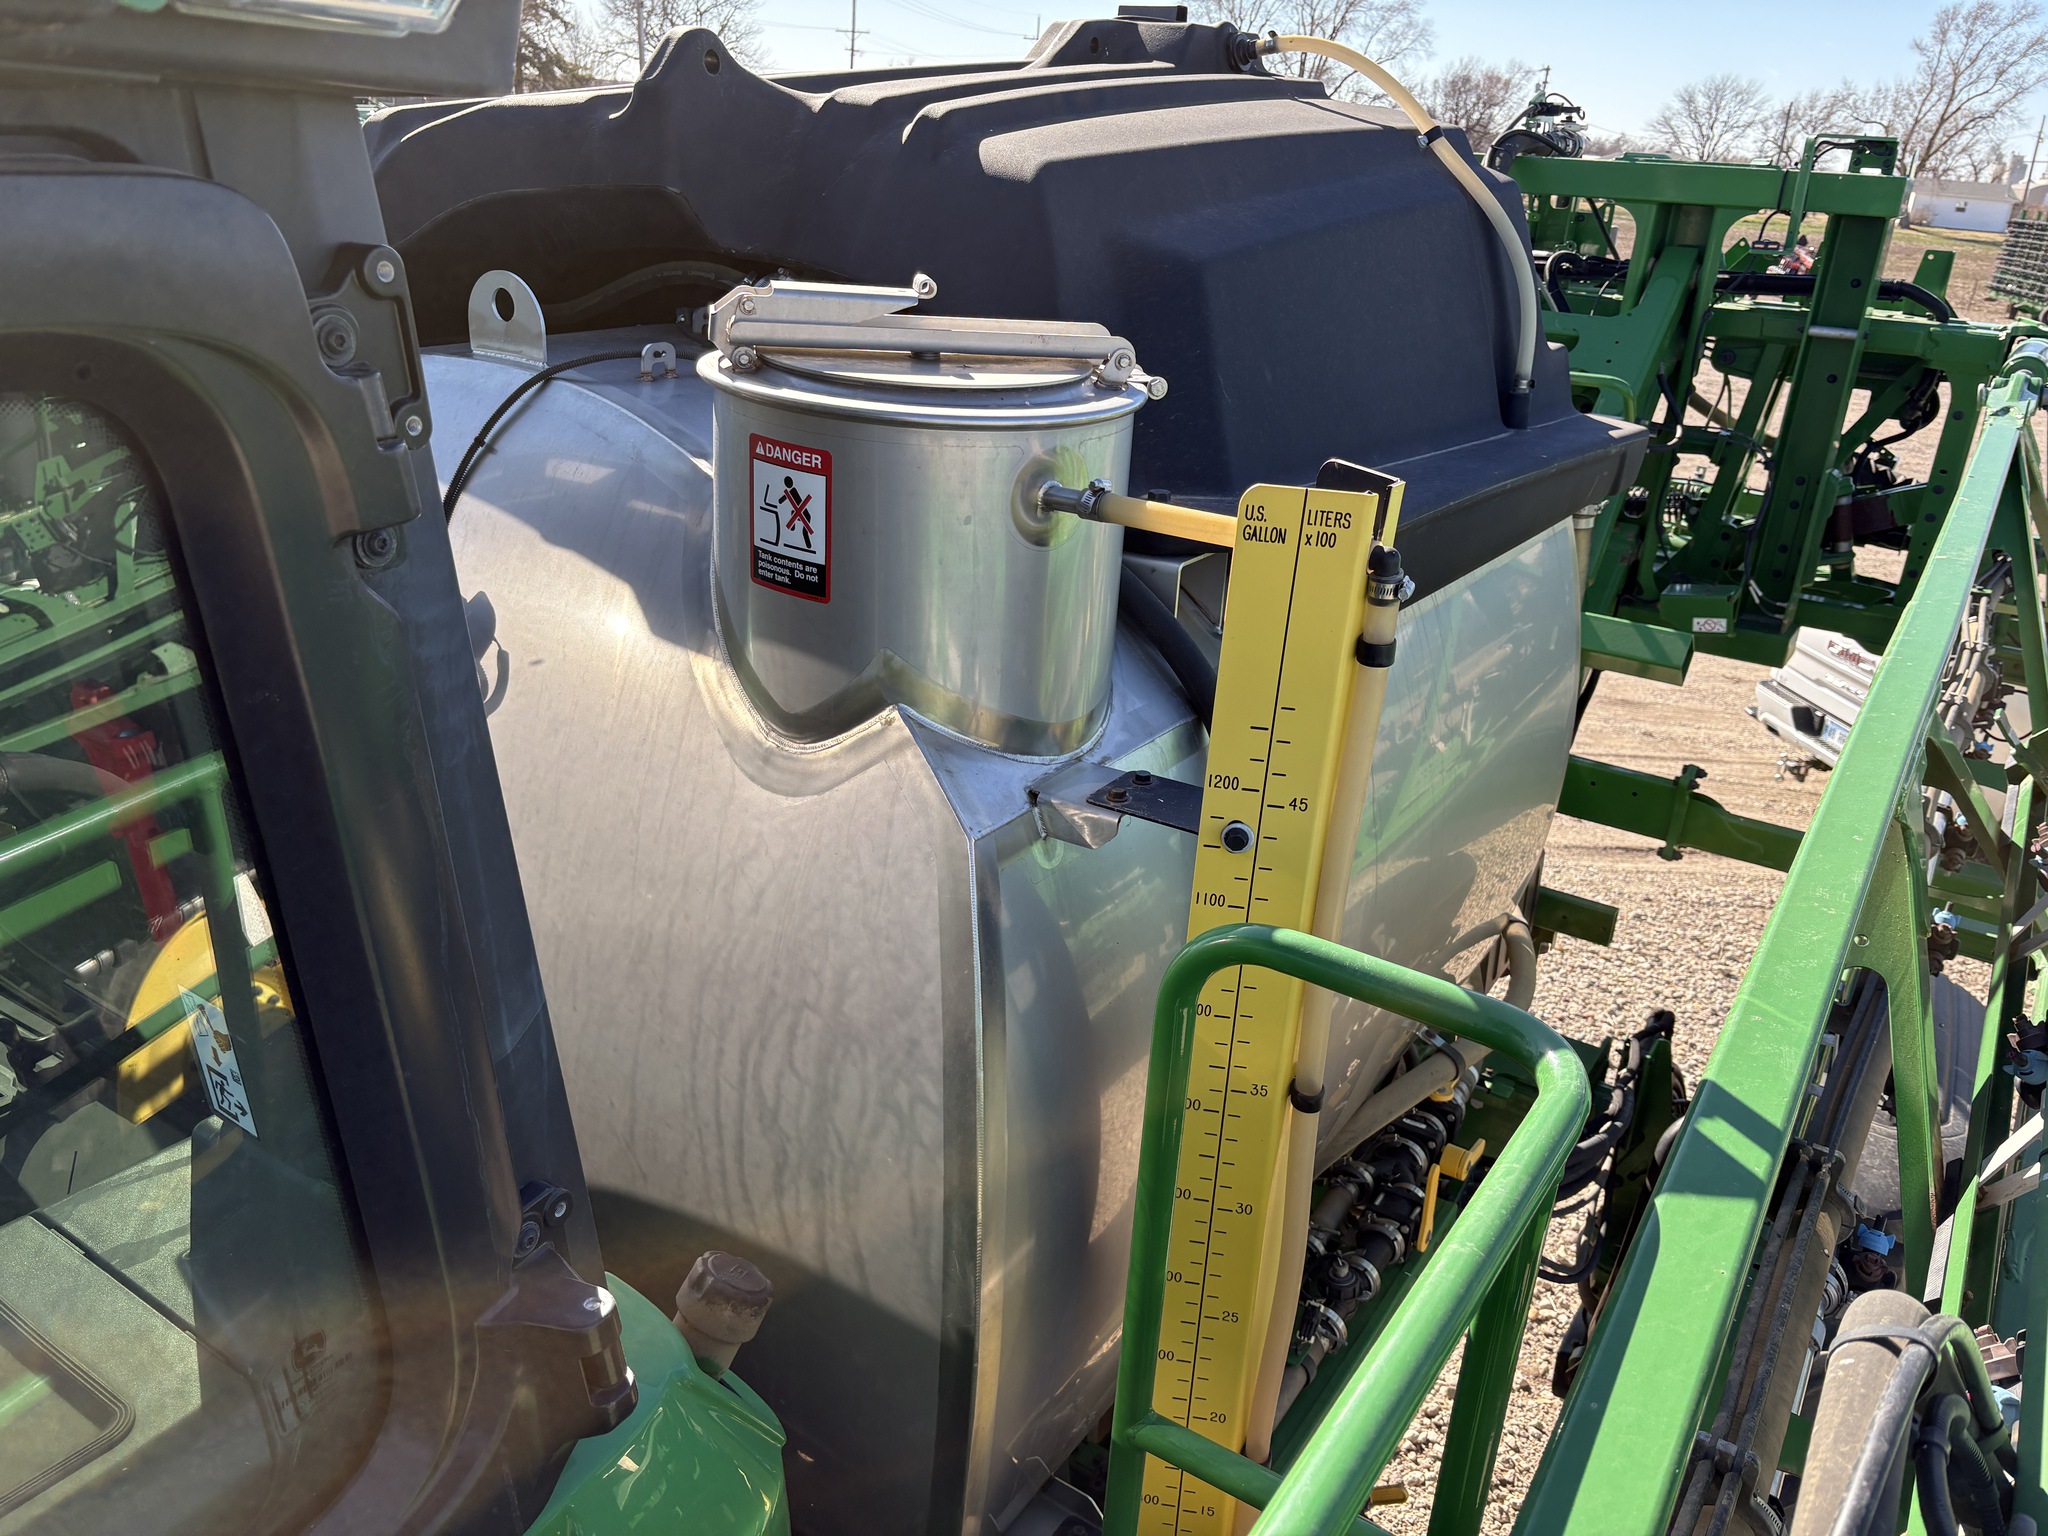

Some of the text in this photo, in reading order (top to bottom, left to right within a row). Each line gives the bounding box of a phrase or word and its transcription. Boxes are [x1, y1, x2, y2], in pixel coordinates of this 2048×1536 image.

[766, 443, 822, 469] DANGER
[1244, 504, 1267, 523] U.S.
[1307, 509, 1352, 529] LITERS
[1242, 525, 1287, 545] GALLON
[758, 550, 818, 574] Tank contents are
[758, 561, 819, 583] poisonous. Do not
[758, 568, 792, 584] enter tank.
[1208, 774, 1240, 791] 1200
[1288, 797, 1309, 812] 45
[1195, 892, 1226, 907] 1100
[1196, 1003, 1212, 1017] 00
[1250, 1083, 1269, 1097] 35
[1186, 1098, 1201, 1111] 00
[1175, 1187, 1191, 1200] 00
[1235, 1202, 1253, 1216] 30
[1166, 1270, 1183, 1283] 00
[1221, 1310, 1239, 1323] 25
[1157, 1349, 1175, 1361] 00
[1209, 1411, 1227, 1424] 20
[1142, 1494, 1160, 1506] 00
[1200, 1506, 1216, 1517] 15
